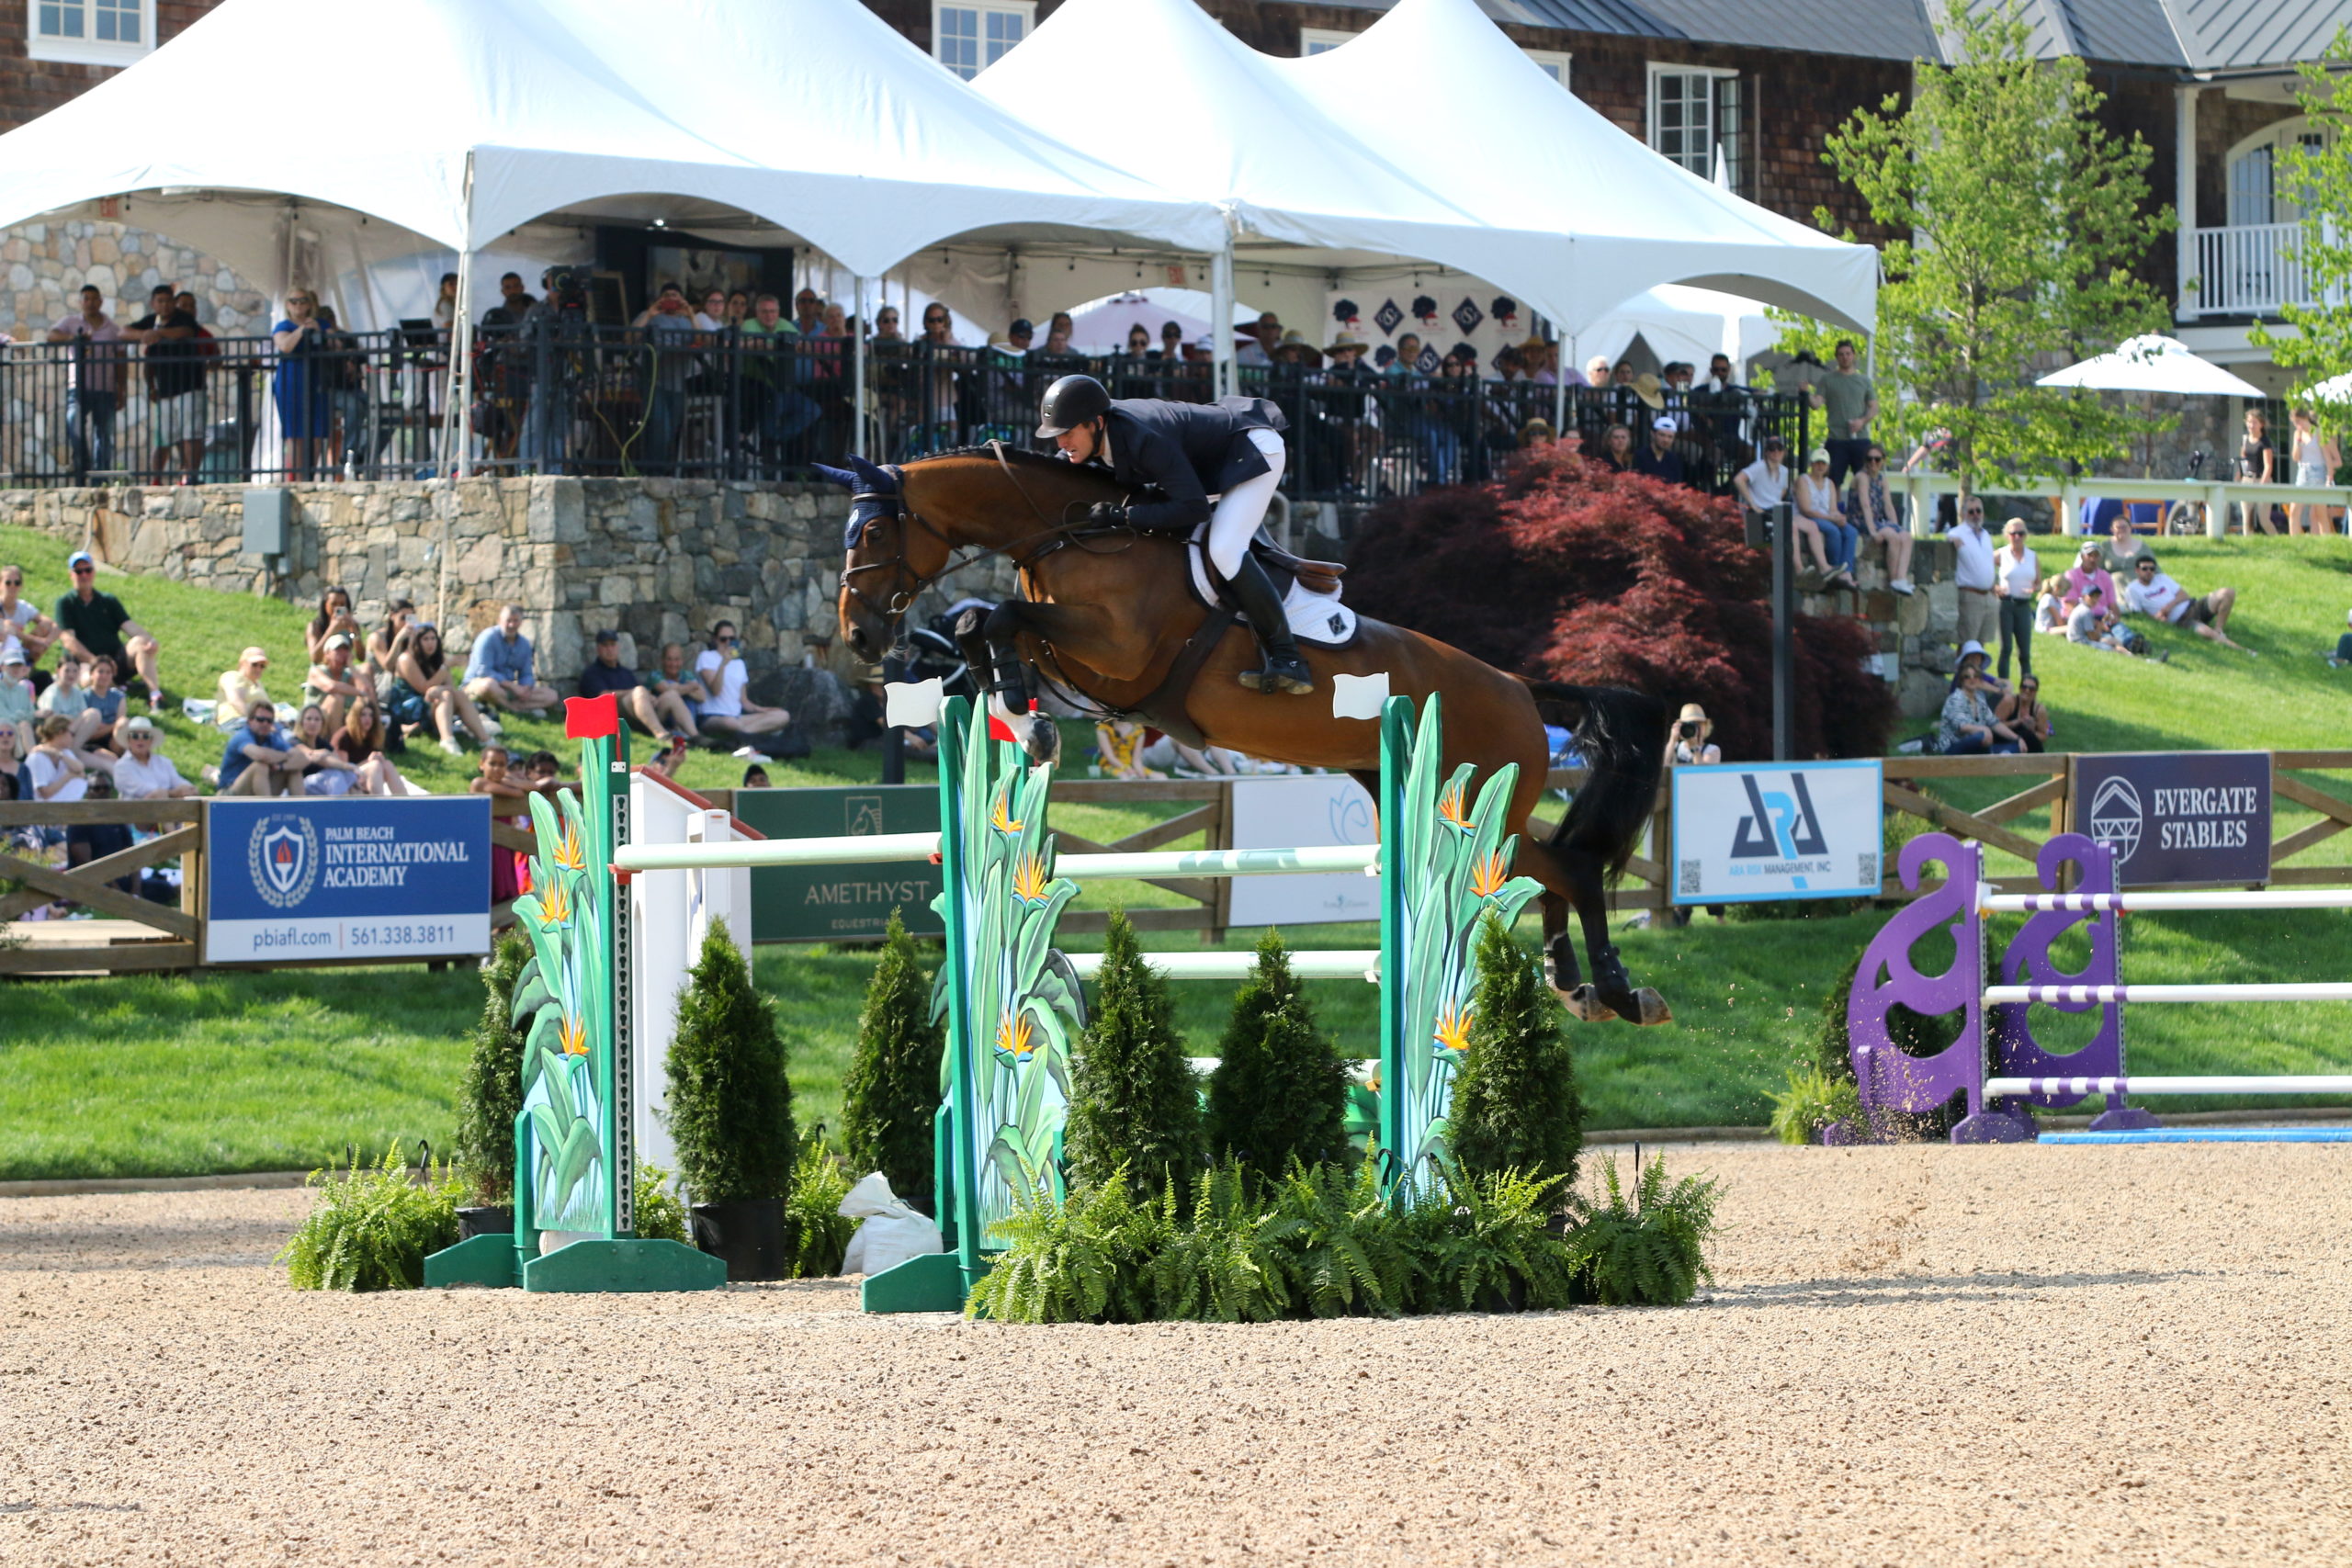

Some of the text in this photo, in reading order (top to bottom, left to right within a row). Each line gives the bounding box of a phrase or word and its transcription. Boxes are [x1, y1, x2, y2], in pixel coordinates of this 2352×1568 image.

[2154, 786, 2257, 817] EVERGATE
[1730, 773, 1828, 860] ARA
[324, 826, 394, 840] PALM BEACH
[2161, 819, 2247, 851] STABLES
[325, 841, 469, 864] INTERNATIONAL
[322, 866, 408, 888] ACADEMY
[1816, 862, 1831, 872] INC
[805, 881, 930, 904] AMETHYST
[254, 925, 454, 952] pbiafl.com 561.338.3811
